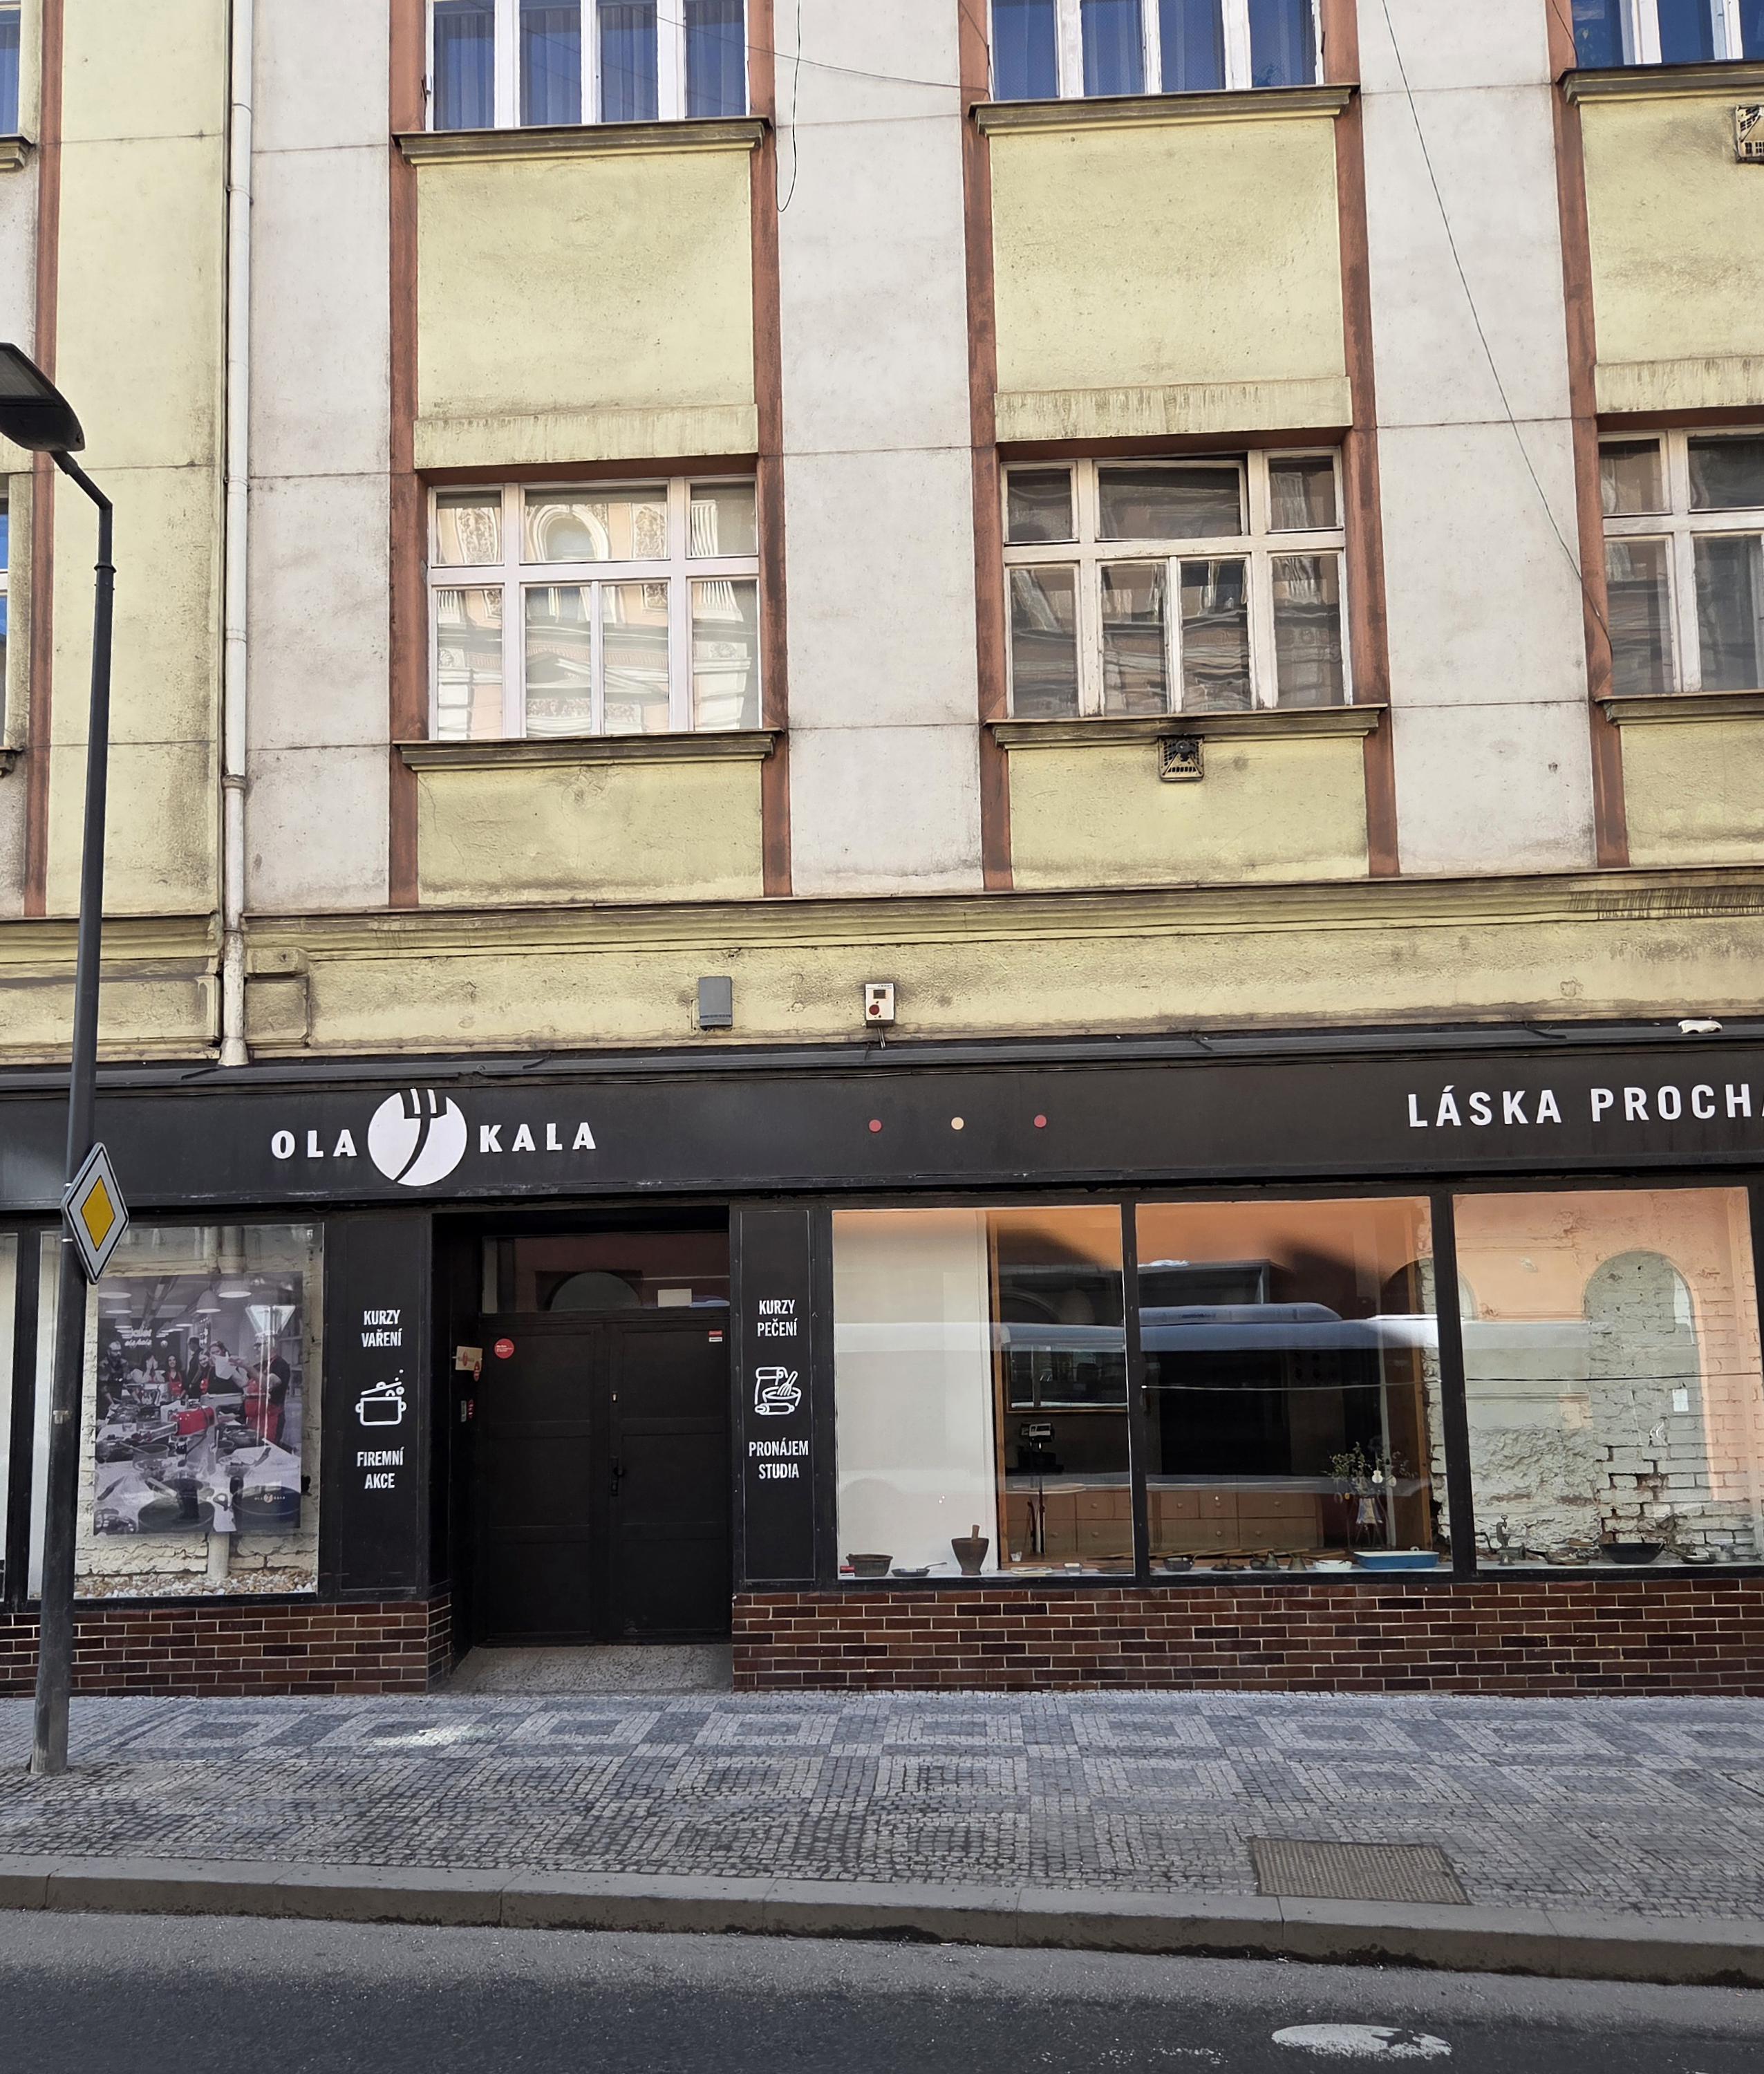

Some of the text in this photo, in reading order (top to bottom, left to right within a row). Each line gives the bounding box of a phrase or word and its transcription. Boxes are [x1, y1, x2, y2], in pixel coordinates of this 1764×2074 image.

[1407, 1083, 1764, 1128] LÁSKA PROCH
[271, 1121, 597, 1159] OLA KALA
[364, 1309, 401, 1325] KURZY
[759, 1299, 796, 1315] KURZY
[361, 1327, 403, 1347] VAŘENÍ
[757, 1317, 798, 1337] PEČENÍ
[357, 1446, 404, 1467] FIREMNÍ
[749, 1437, 809, 1457] PRONÁJEM
[364, 1473, 395, 1489] AKCE
[758, 1463, 800, 1479] STUDIA
